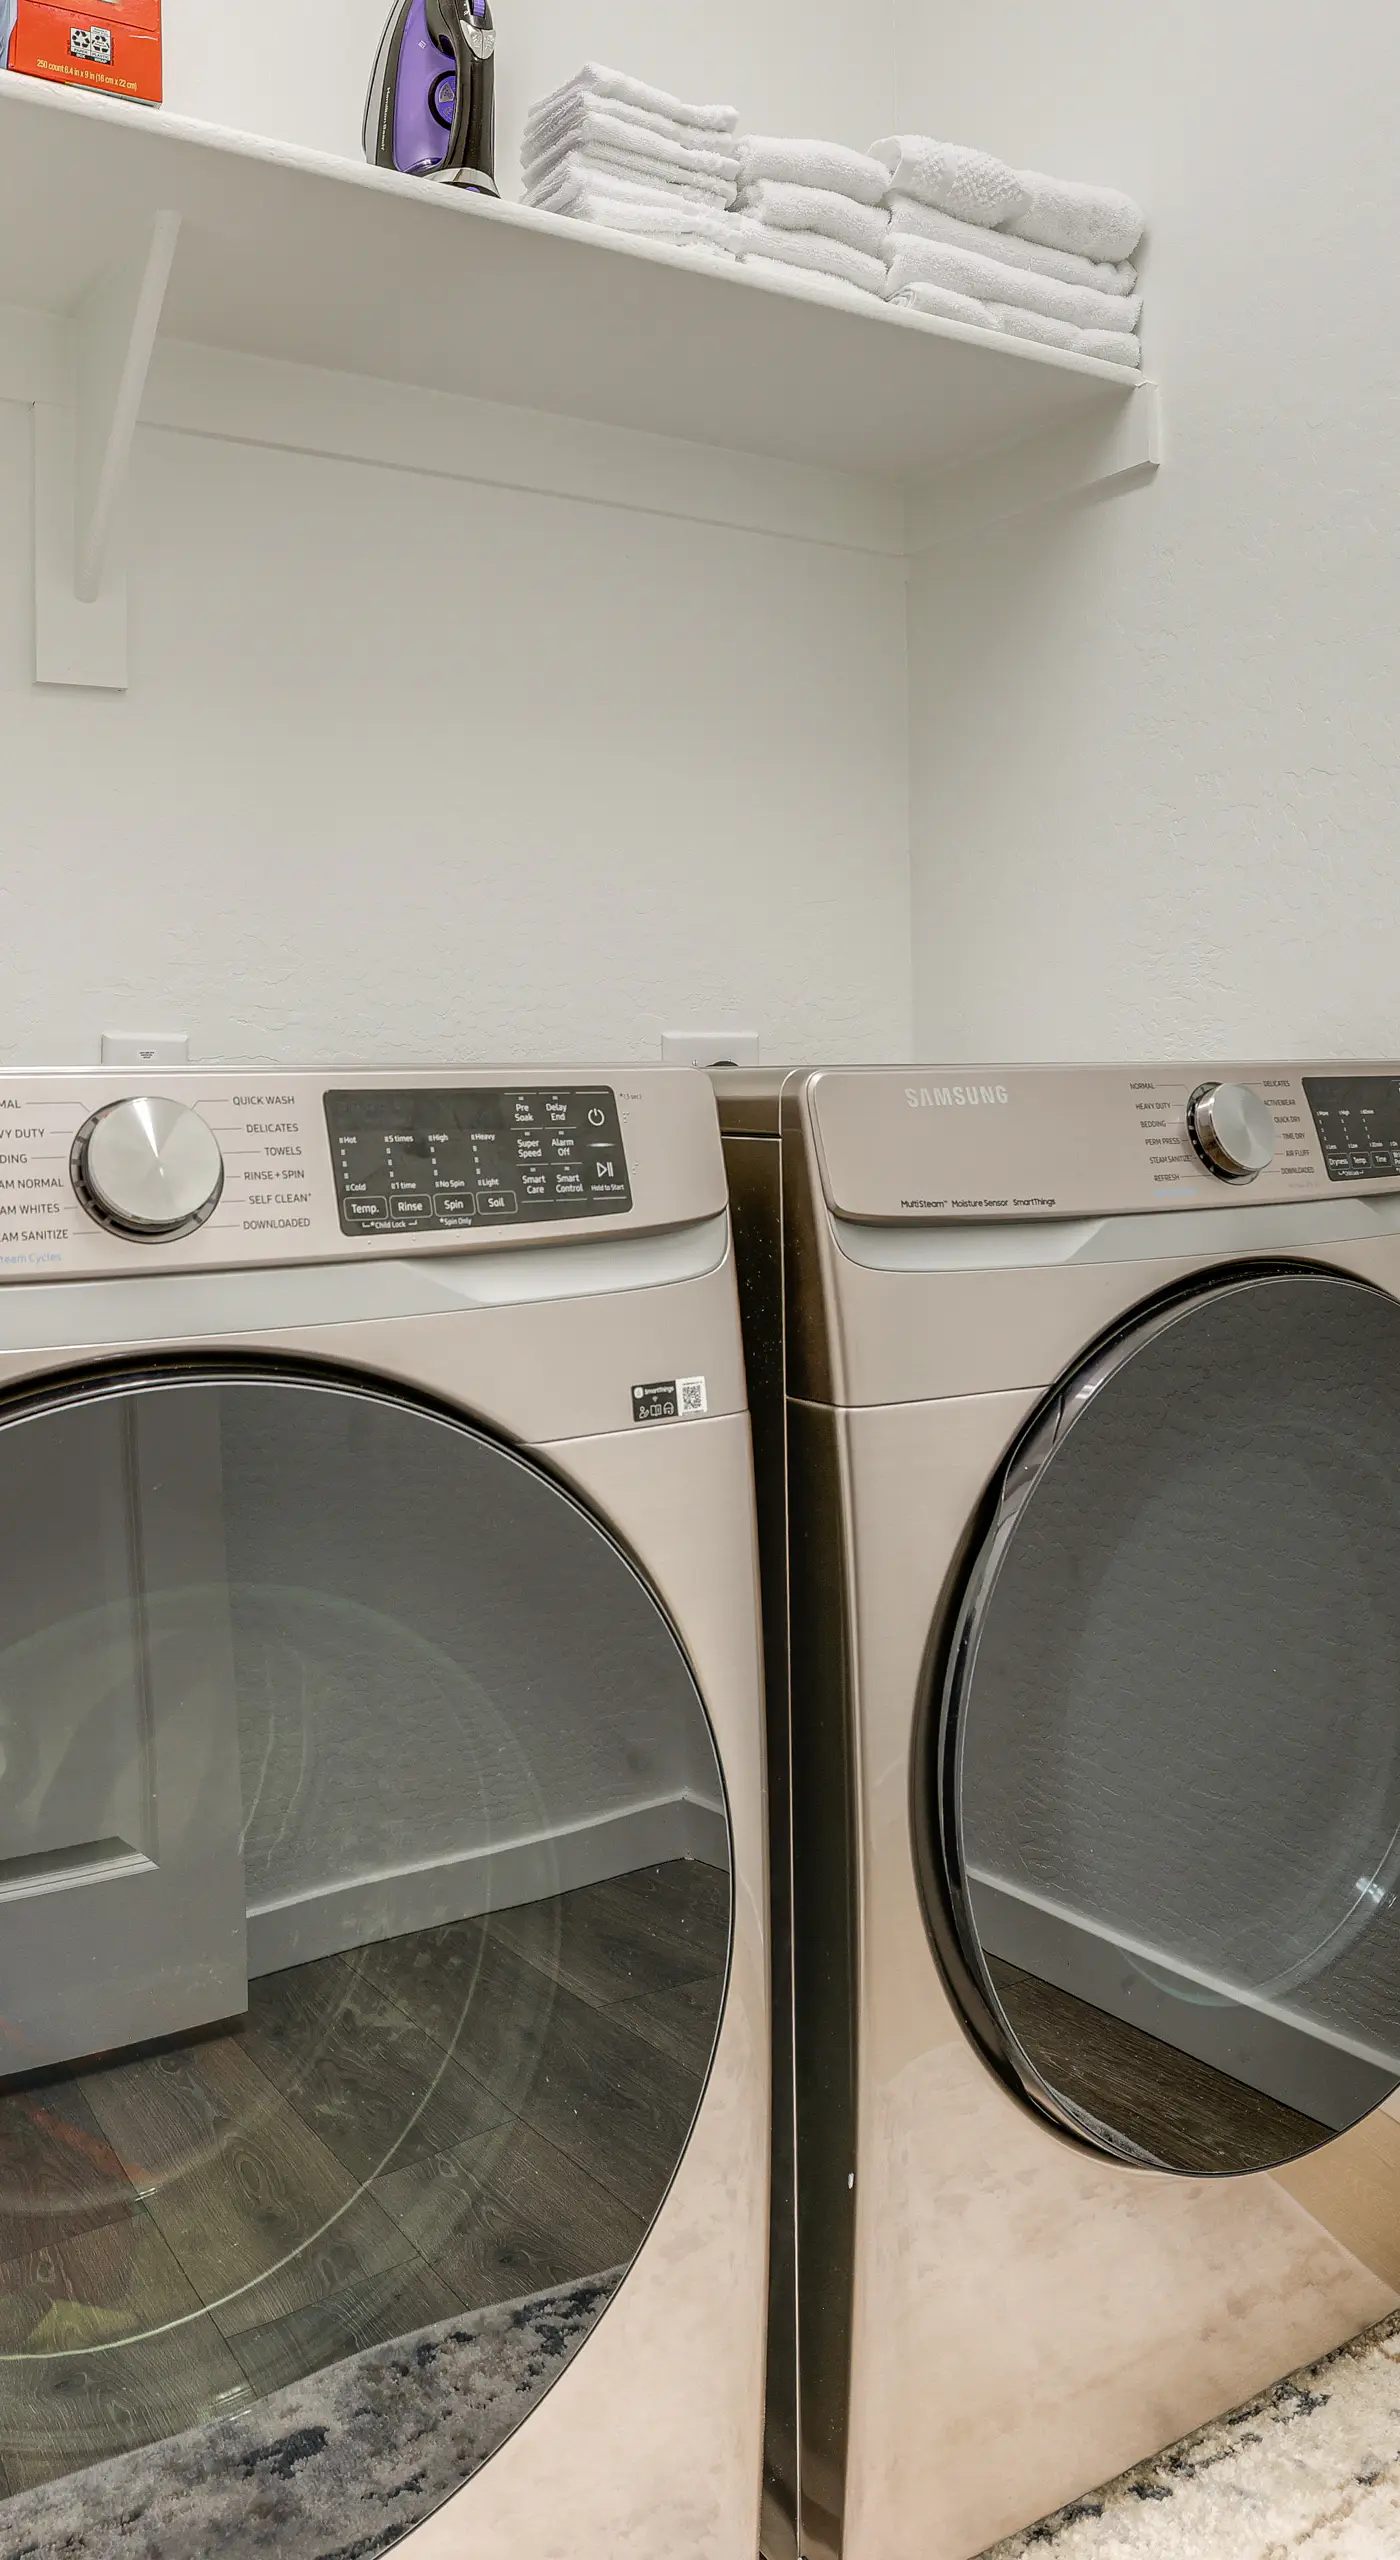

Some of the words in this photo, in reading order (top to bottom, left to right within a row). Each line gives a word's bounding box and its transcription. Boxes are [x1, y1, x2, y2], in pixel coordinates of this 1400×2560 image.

[36, 59, 48, 69] 250
[48, 62, 64, 73] count
[104, 75, 114, 84] cm
[118, 79, 126, 88] 22
[1129, 1082, 1156, 1091] NORMAL
[1262, 1080, 1291, 1088] DELICATES
[232, 1096, 264, 1106] QUICK
[265, 1096, 295, 1105] WASH
[904, 1085, 1009, 1108] SAMSUNG
[515, 1103, 530, 1112] Pre
[545, 1103, 568, 1113] Delay
[1135, 1102, 1155, 1111] HEAVY
[1155, 1102, 1171, 1110] DUTY
[514, 1112, 534, 1122] Soak
[550, 1112, 566, 1121] End
[1273, 1116, 1290, 1124] QUICK
[246, 1123, 299, 1133] DELICATES
[1140, 1120, 1167, 1129] BEDDING
[15, 1128, 45, 1139] DUTY
[394, 1134, 414, 1142] times
[475, 1133, 496, 1141] Heavy
[1294, 1132, 1306, 1140] DRY
[343, 1136, 357, 1144] Hot
[432, 1134, 449, 1143] High
[551, 1138, 574, 1147] Alarm
[1144, 1138, 1162, 1146] PERM
[1162, 1137, 1181, 1145] PRESS
[517, 1139, 540, 1149] Super
[264, 1146, 302, 1156] TOWELS
[518, 1149, 542, 1159] Speed
[557, 1147, 571, 1156] Off
[1149, 1156, 1167, 1164] STEAM
[244, 1170, 273, 1180] RINSE
[281, 1169, 305, 1179] SPIN
[556, 1174, 580, 1183] Smart
[1153, 1174, 1180, 1182] REFRESH
[17, 1178, 64, 1189] NORMAL
[439, 1180, 450, 1188] No
[449, 1179, 465, 1189] Spin
[482, 1179, 500, 1188] Light
[522, 1175, 546, 1184] Smart
[350, 1183, 367, 1192] Cold
[400, 1181, 417, 1190] time
[526, 1185, 545, 1194] Care
[555, 1183, 584, 1193] Control
[590, 1184, 604, 1192] Hold
[610, 1183, 625, 1192] Start
[248, 1195, 272, 1205] SELF
[487, 1197, 505, 1208] Soil
[951, 1200, 984, 1209] Moisture
[983, 1199, 1009, 1208] Sensor
[1012, 1197, 1056, 1208] SmartThings
[19, 1203, 60, 1214] WHITES
[351, 1203, 380, 1215] Temp.
[397, 1201, 423, 1213] Rinse
[444, 1199, 464, 1211] Spin
[242, 1217, 311, 1230] DOWNLOADED
[391, 1220, 407, 1229] Lock
[457, 1217, 472, 1227] Only
[0, 1231, 19, 1242] AM
[20, 1229, 69, 1241] SANITIZE
[28, 1252, 62, 1264] Cycles
